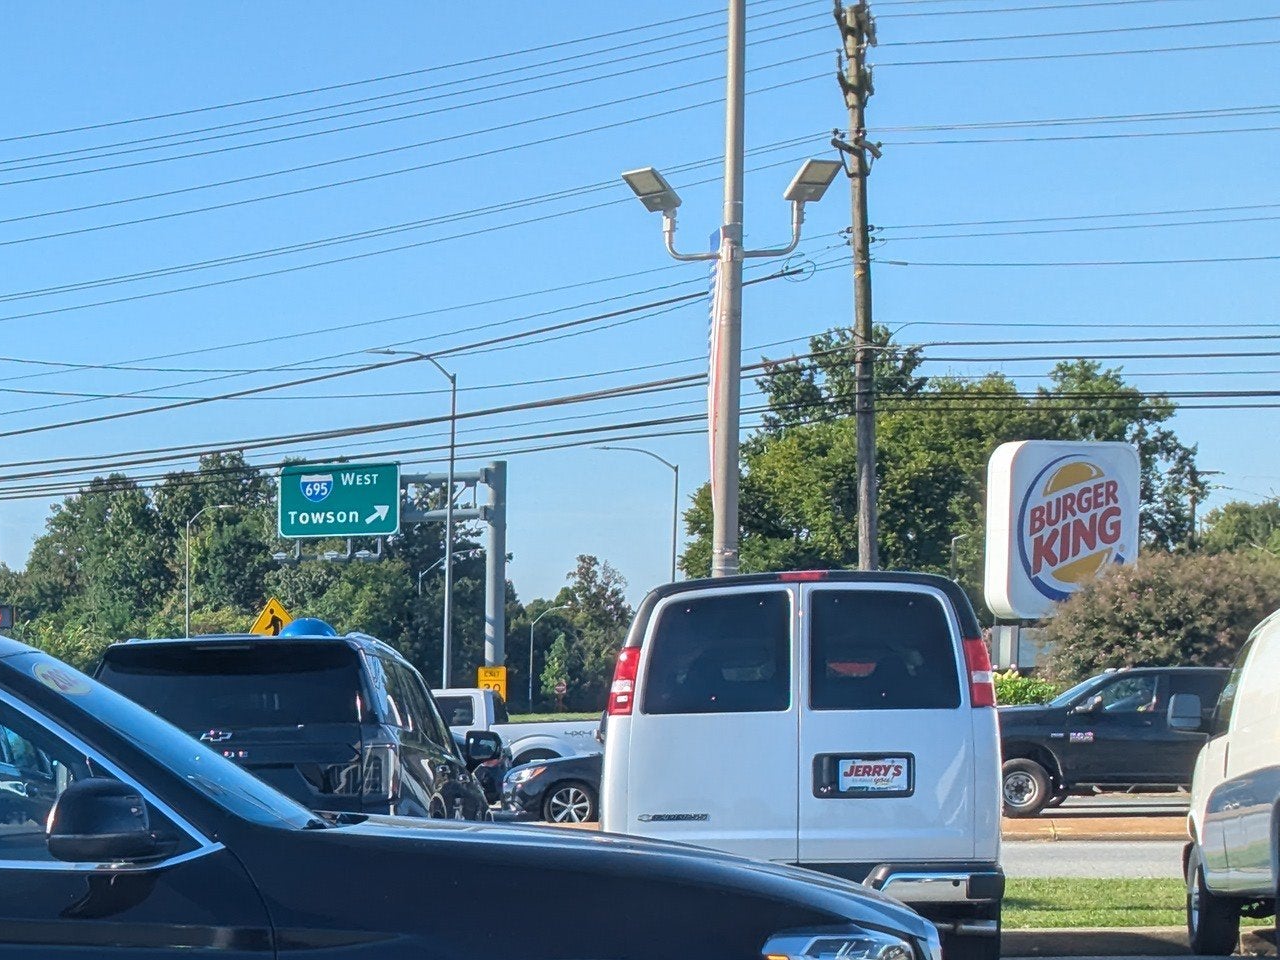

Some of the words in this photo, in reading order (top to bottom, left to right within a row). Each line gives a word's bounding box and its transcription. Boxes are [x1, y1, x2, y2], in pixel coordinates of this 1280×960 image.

[305, 483, 328, 496] 695
[1029, 480, 1118, 537] BURGER
[1032, 506, 1122, 576] KING
[843, 765, 902, 777] JERRY'S
